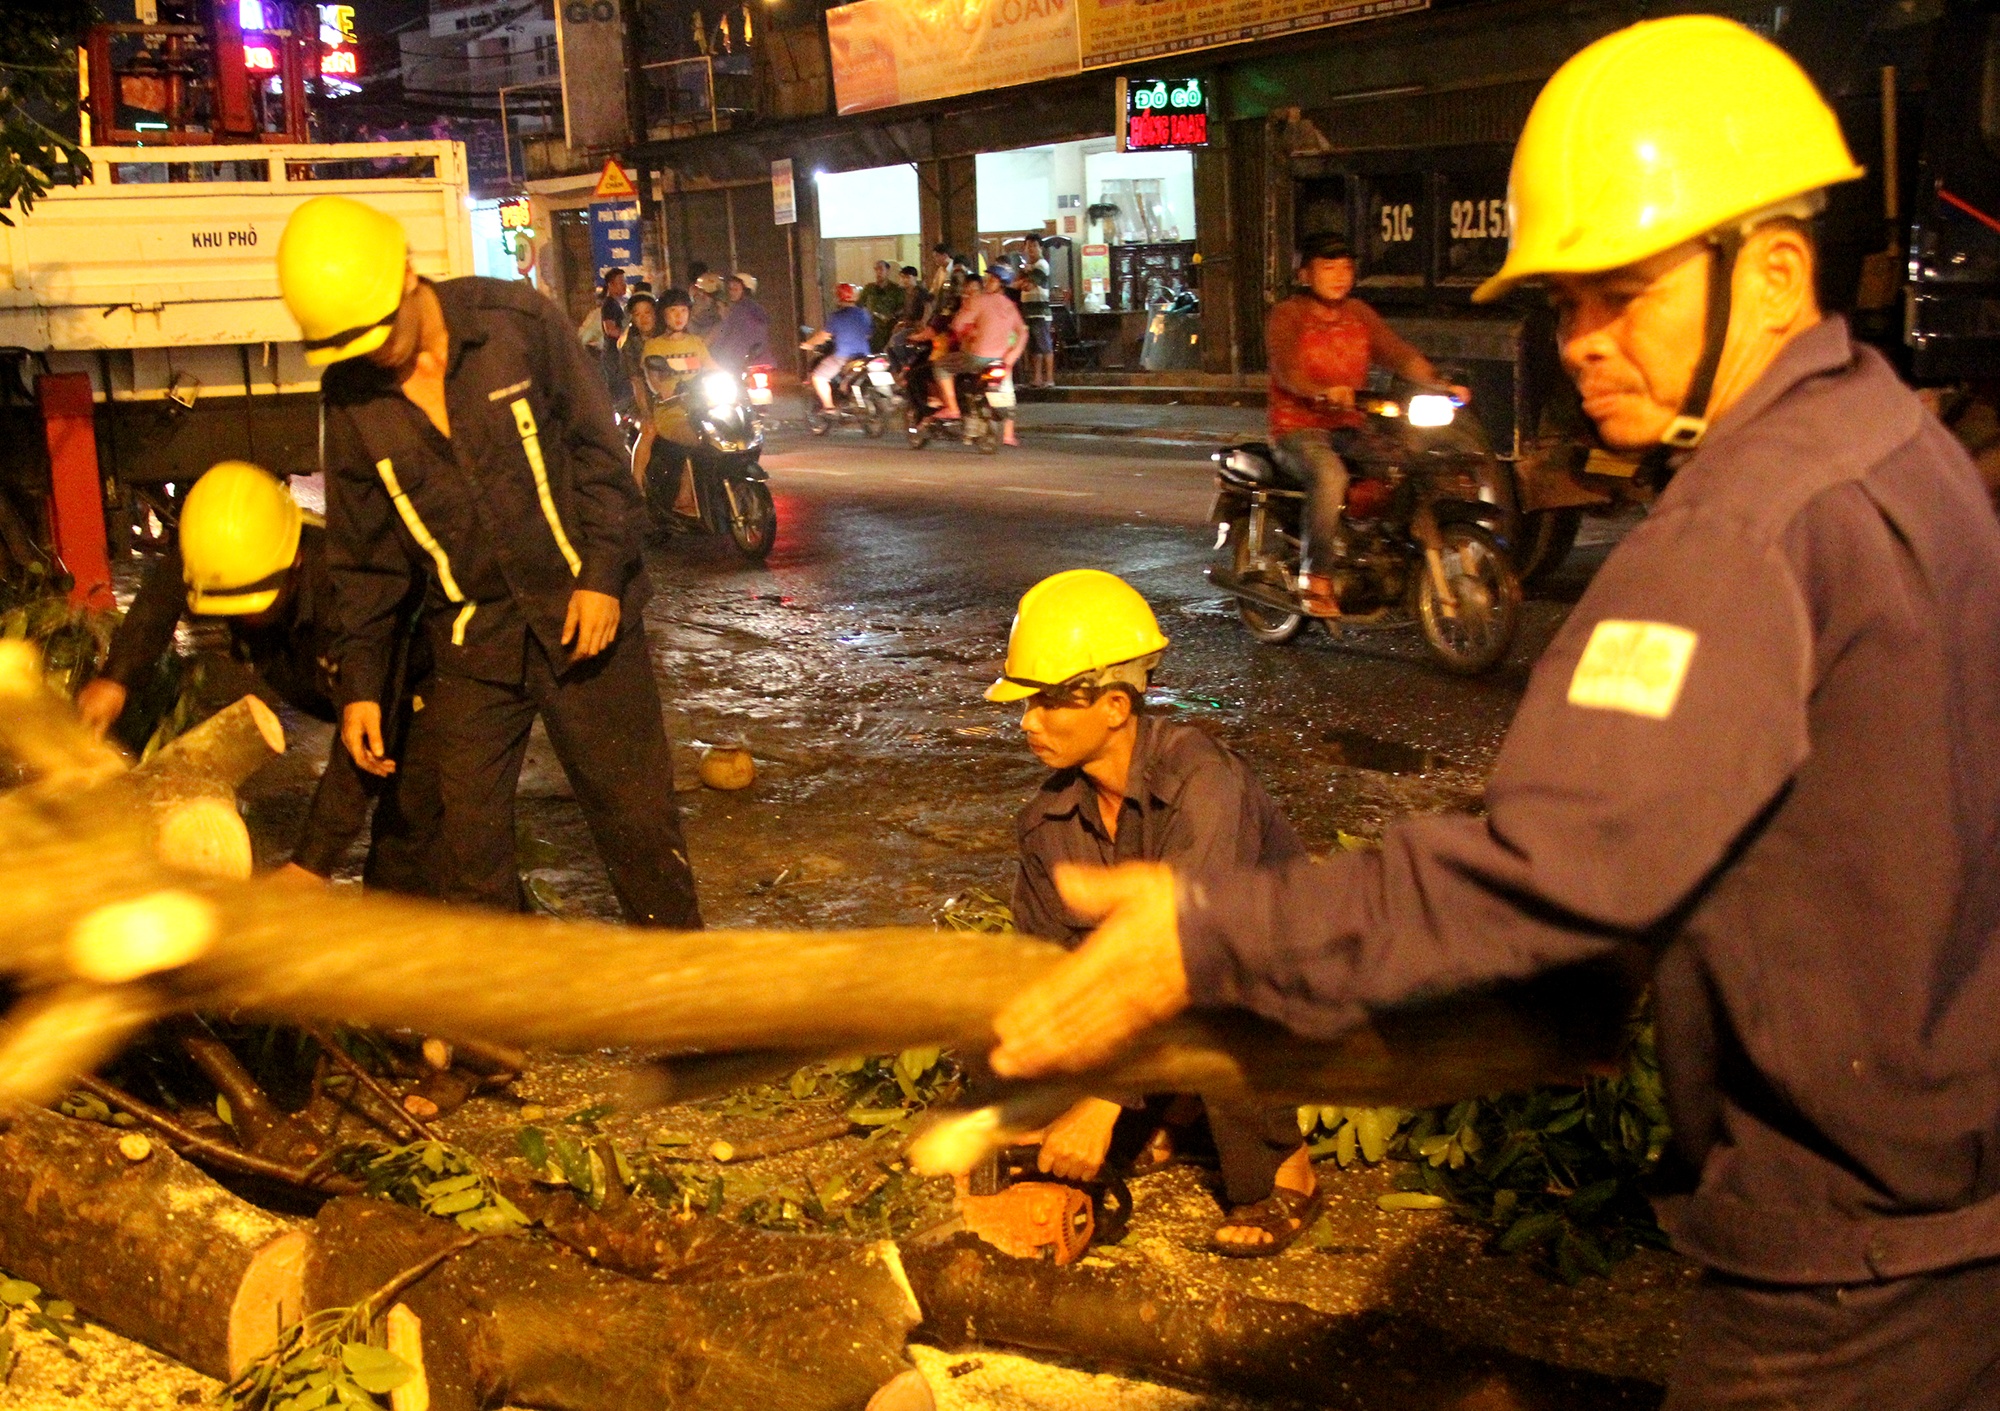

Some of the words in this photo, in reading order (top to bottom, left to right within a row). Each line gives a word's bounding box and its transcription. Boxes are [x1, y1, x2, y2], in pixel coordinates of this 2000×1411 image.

[1170, 113, 1207, 145] LOAN
[1381, 203, 1414, 242] 51C
[192, 232, 222, 248] KHU
